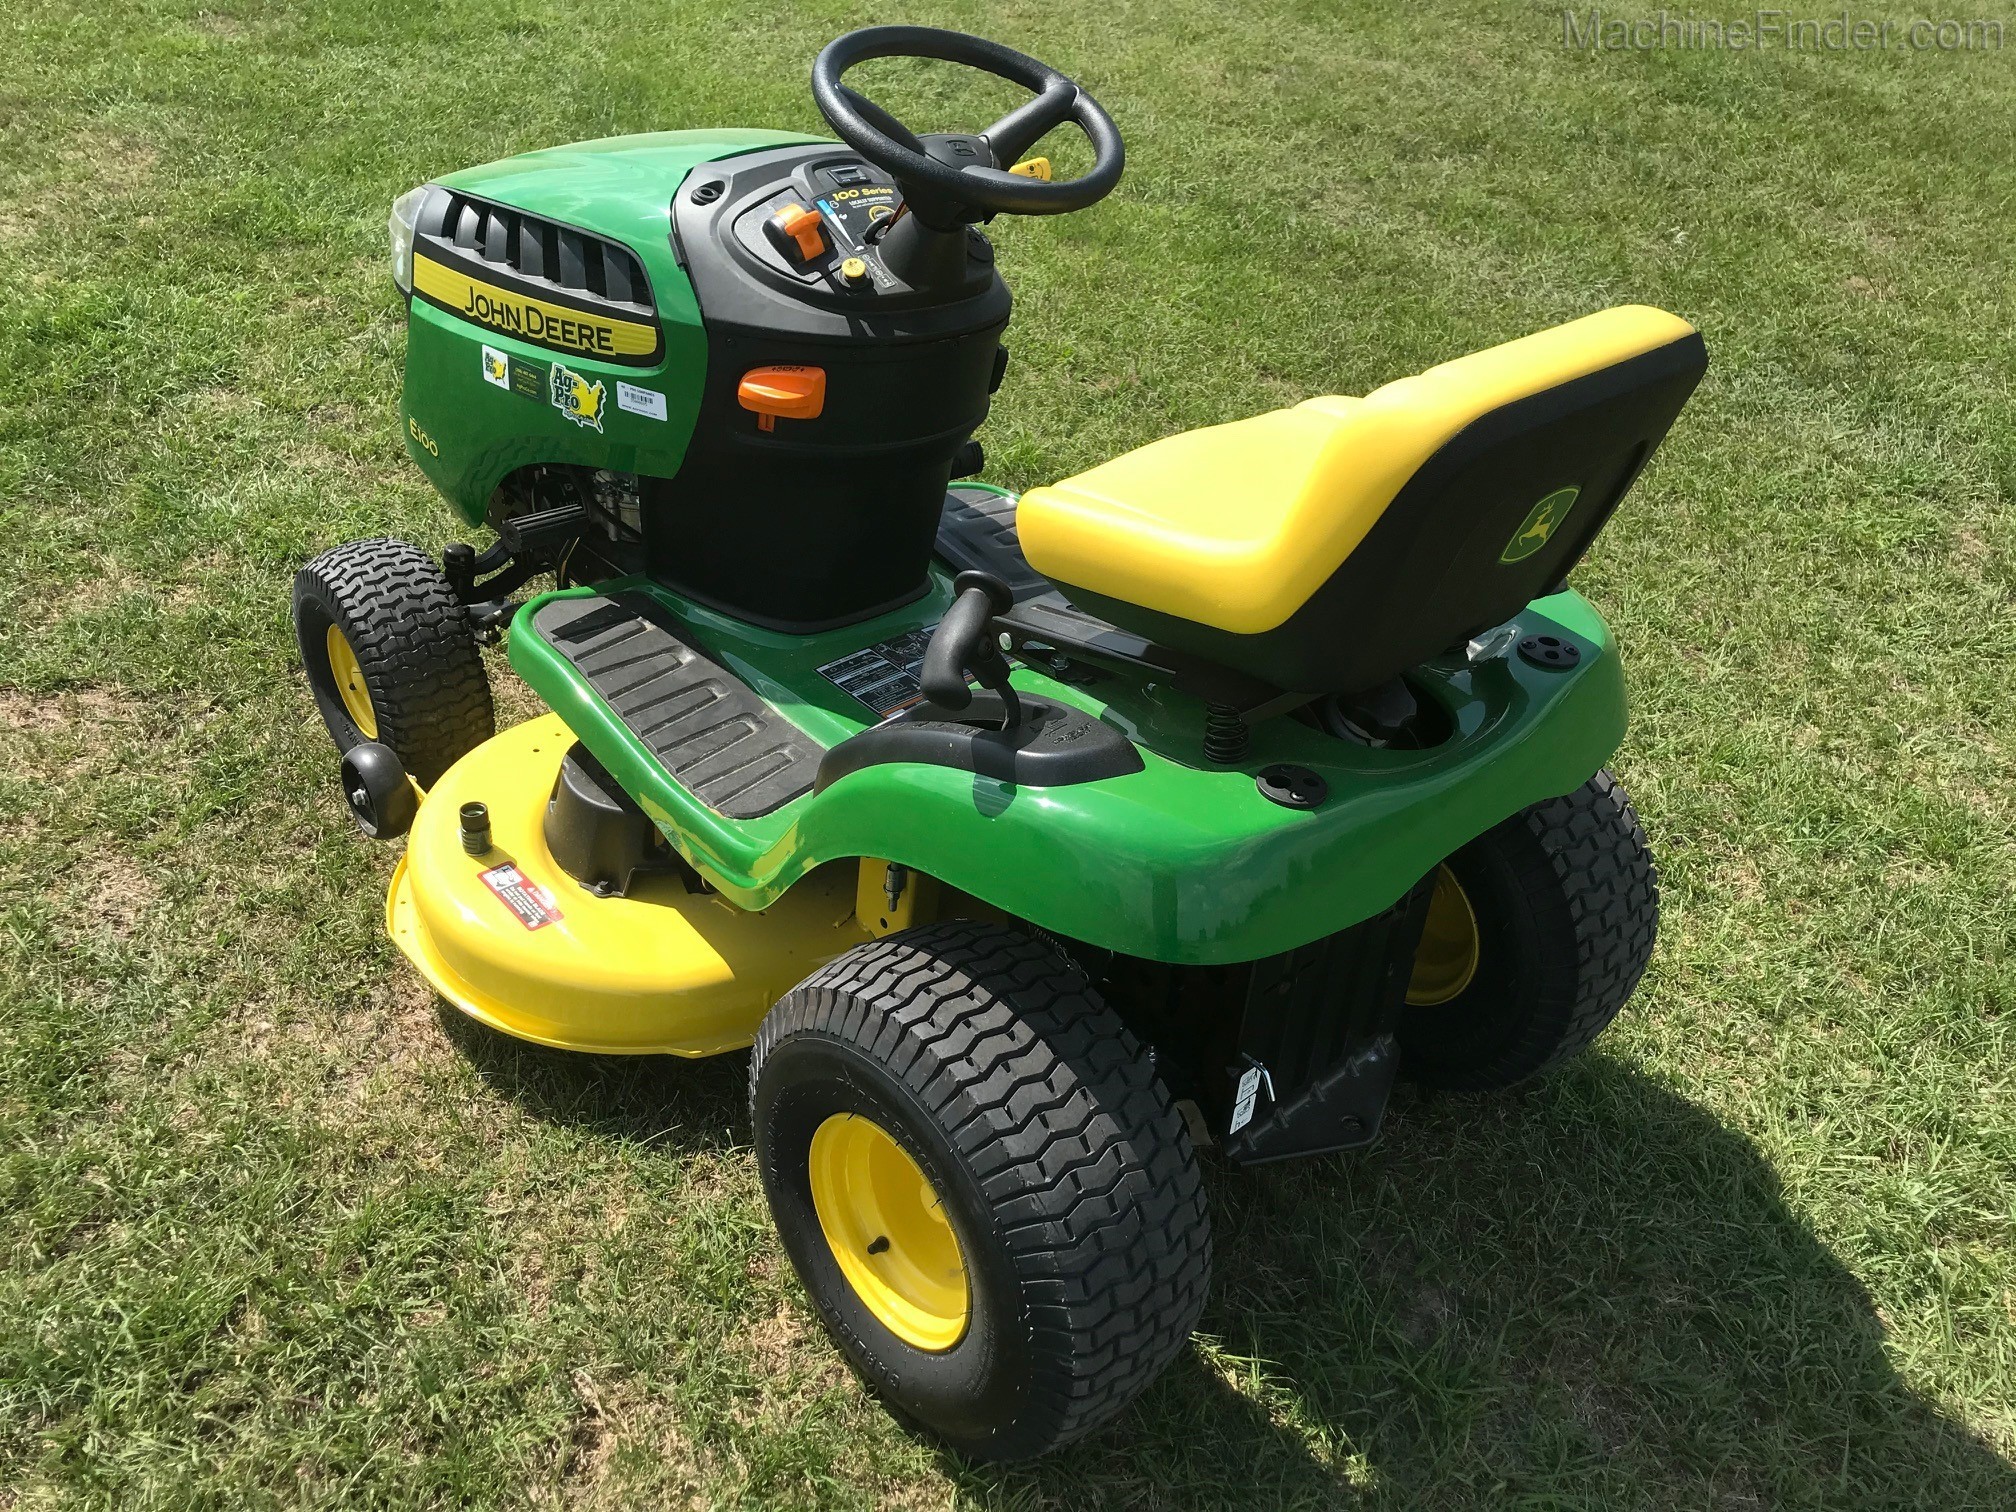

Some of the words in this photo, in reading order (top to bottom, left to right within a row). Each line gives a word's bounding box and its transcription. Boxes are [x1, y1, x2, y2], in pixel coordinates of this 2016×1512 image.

[832, 189, 860, 202] 100
[862, 187, 894, 196] Series
[464, 286, 522, 331] JOHN
[526, 305, 615, 352] DEERE
[554, 366, 578, 393] Ag-
[554, 385, 580, 409] Pro
[409, 416, 439, 457] E100
